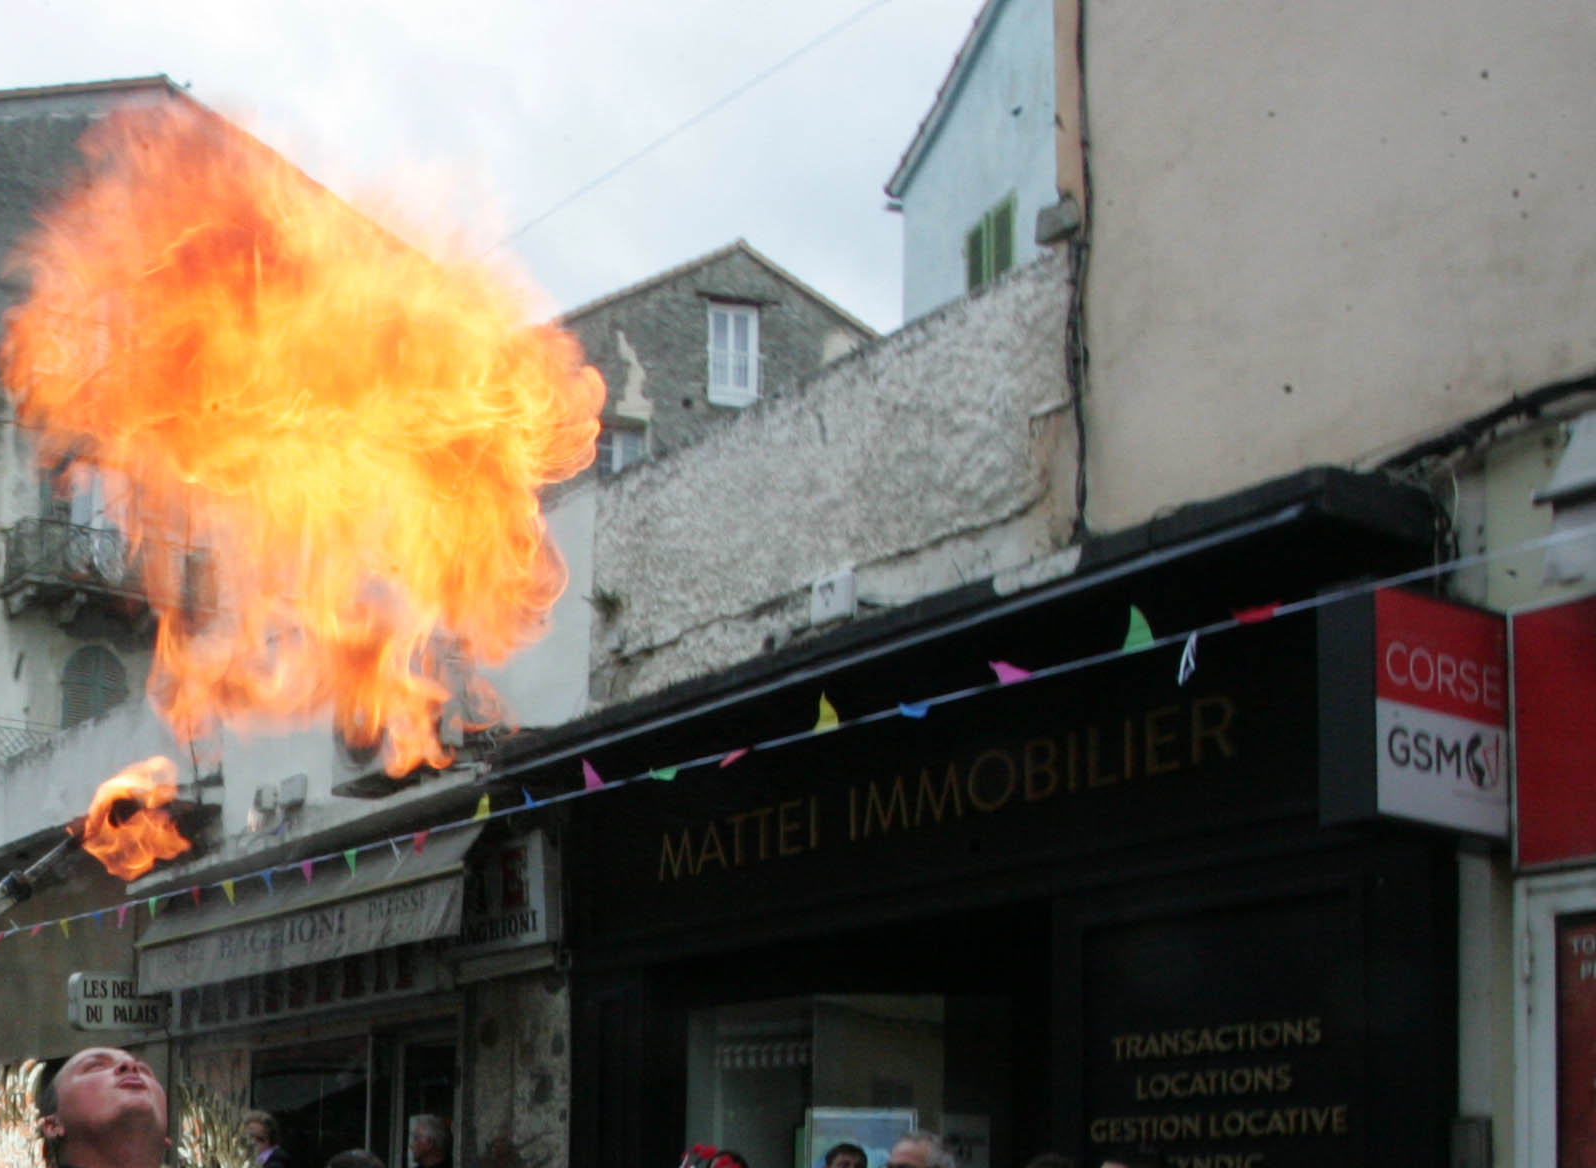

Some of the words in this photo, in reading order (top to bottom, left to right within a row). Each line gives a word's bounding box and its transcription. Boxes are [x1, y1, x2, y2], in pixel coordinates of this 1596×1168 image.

[1385, 640, 1502, 709] CORSE
[1387, 725, 1462, 780] GSM
[657, 796, 820, 882] MATTEI
[847, 694, 1237, 842] IMMOBILIER
[83, 980, 108, 999] LES
[85, 1005, 102, 1023] DU
[113, 1005, 158, 1023] PALAIS
[1111, 1017, 1322, 1062] TRANSACTIONS
[1135, 1064, 1293, 1101] LOCATIONS
[1090, 1113, 1201, 1144] GESTION
[1208, 1104, 1349, 1140] LOCATIVE
